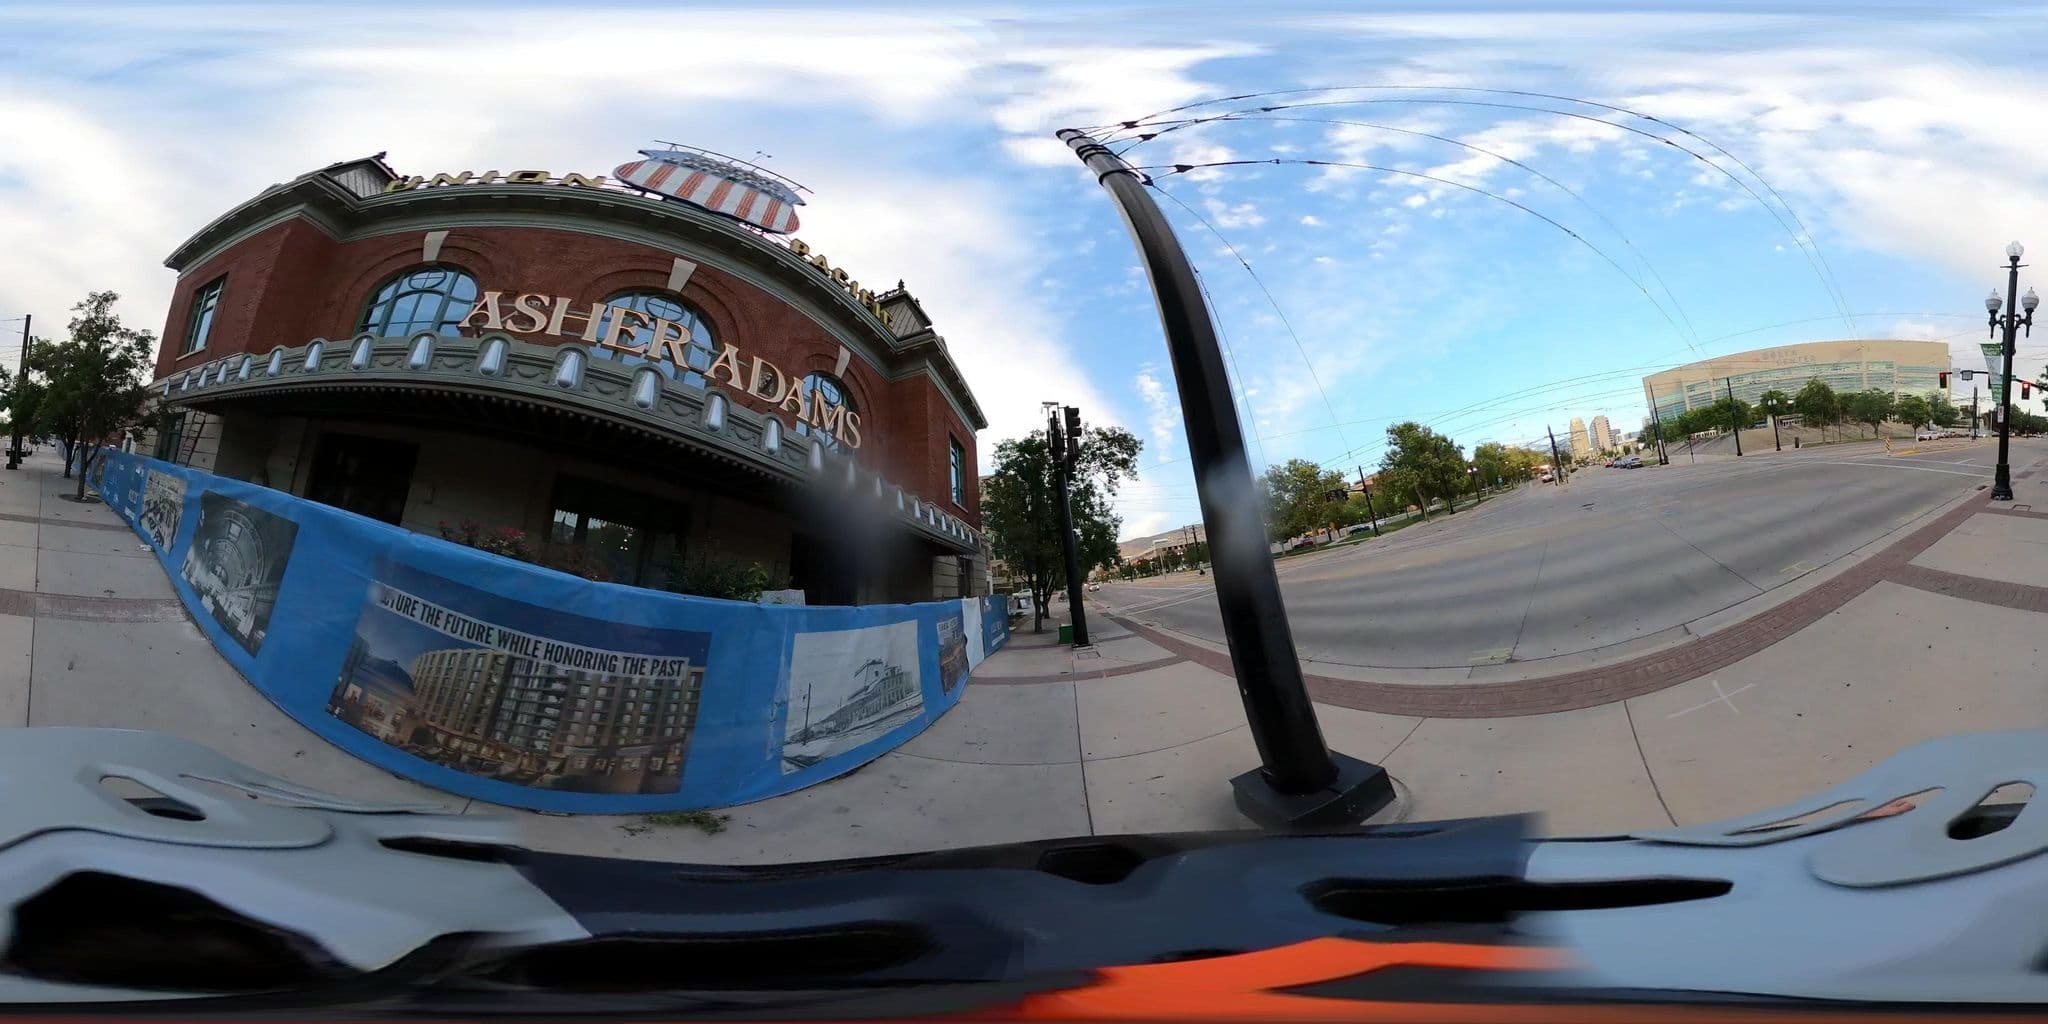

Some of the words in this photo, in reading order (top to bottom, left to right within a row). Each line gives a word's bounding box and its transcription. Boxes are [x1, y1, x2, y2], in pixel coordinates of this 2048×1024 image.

[385, 170, 607, 192] UNION
[790, 238, 895, 333] PACIFIC
[457, 291, 691, 371] ASHER
[703, 342, 862, 449] ADAMS
[419, 603, 444, 628] THE
[443, 613, 495, 645] FUTURE
[497, 629, 542, 658] WHILE
[543, 642, 618, 673] HONORING
[622, 655, 650, 676] THE
[650, 658, 685, 677] PAST
